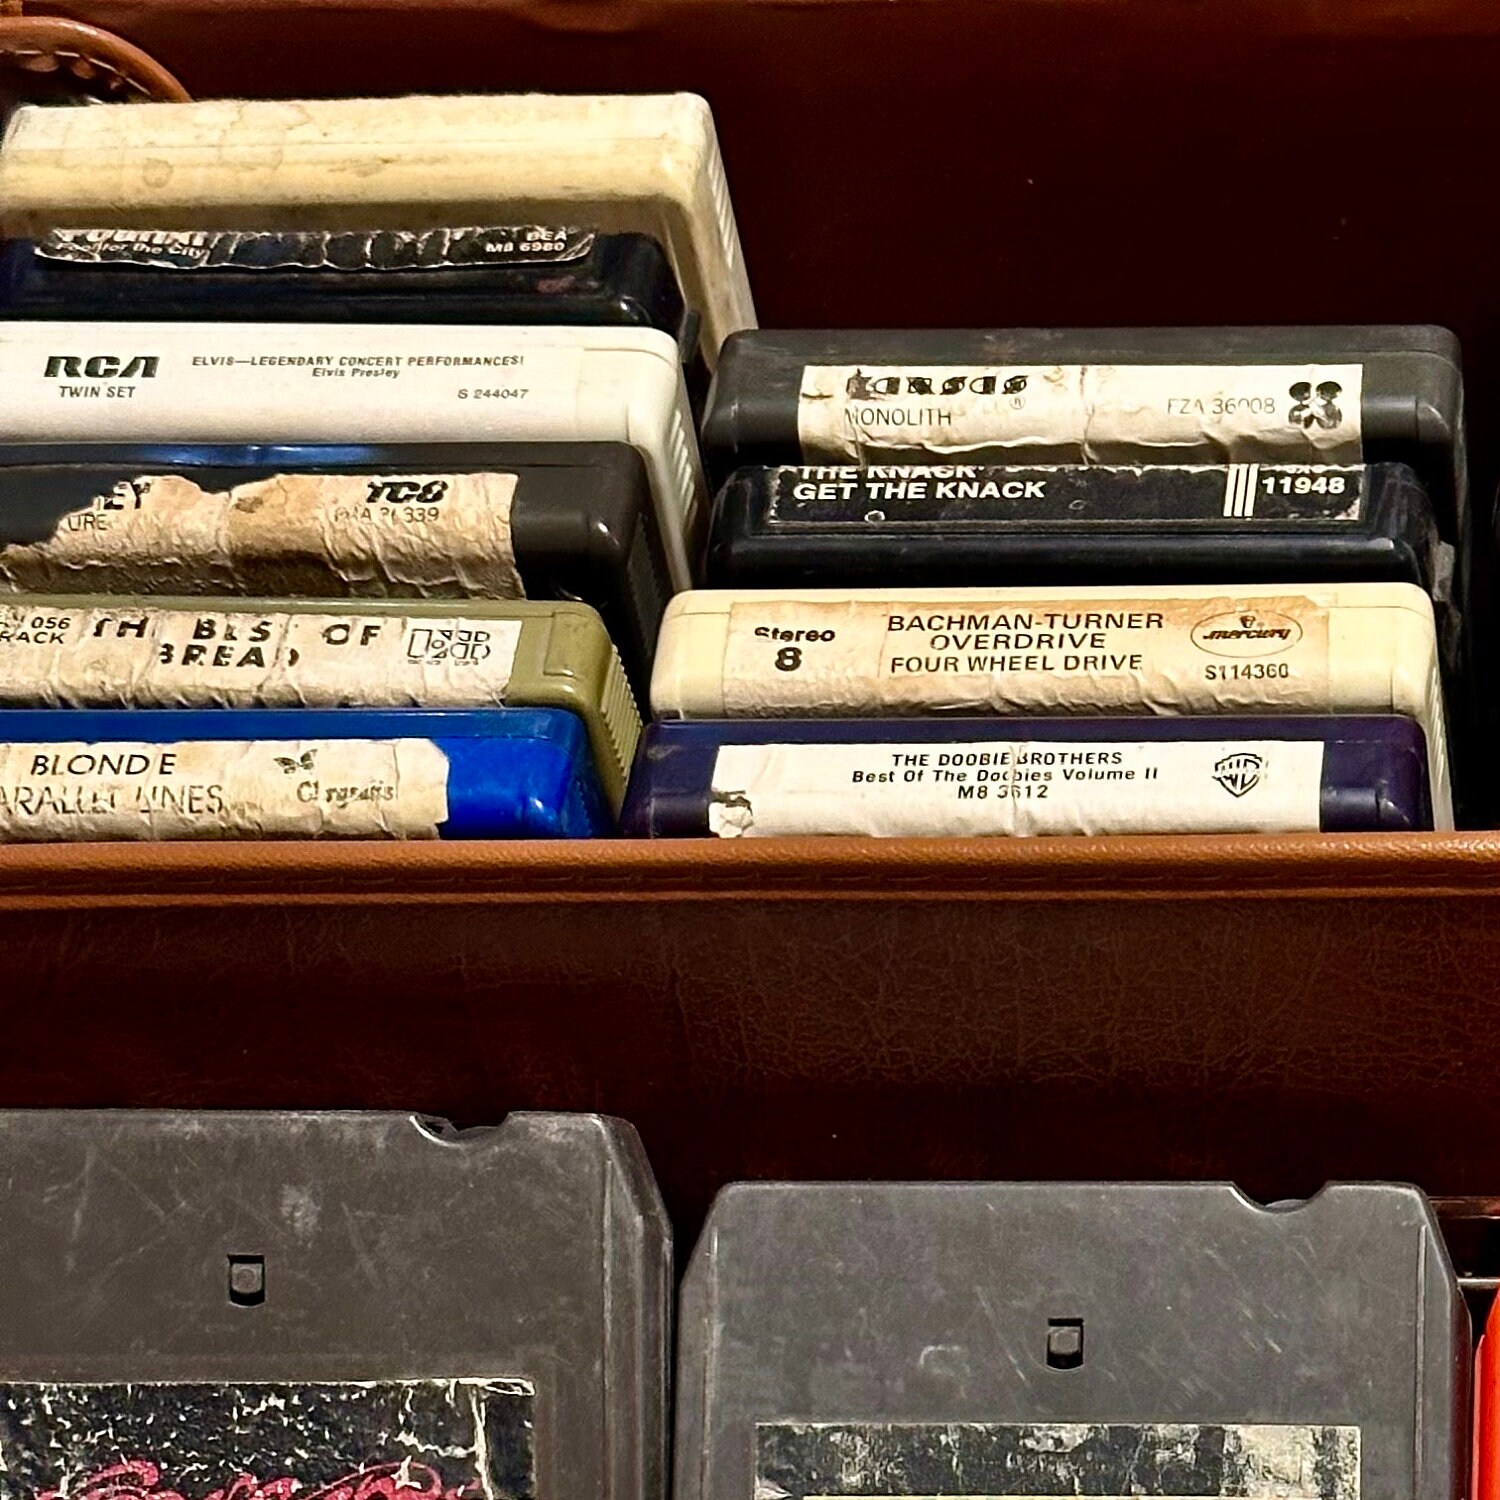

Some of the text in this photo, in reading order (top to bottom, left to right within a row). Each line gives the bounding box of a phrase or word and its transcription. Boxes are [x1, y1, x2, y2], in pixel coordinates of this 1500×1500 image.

[44, 355, 160, 379] RCA
[339, 355, 403, 367] CONCERT
[312, 368, 400, 380] Elvis Presley
[59, 386, 136, 398] TWIN SET
[457, 389, 529, 399] S 244047
[366, 480, 449, 504] TC8
[793, 480, 1047, 500] GET THE KNACK
[1262, 476, 1346, 495] 11948
[887, 612, 1164, 632] BACHMAN-TURNER
[321, 623, 381, 646] OF
[754, 626, 836, 643] Stereo
[929, 632, 1107, 652] OVERDRIVE
[774, 647, 803, 672] 8
[891, 654, 1143, 674] FOUR WHEEL DRIVE
[1205, 663, 1289, 681] S114360
[892, 752, 1123, 767] THE DOOBIE BROTHERS
[852, 770, 895, 783] Best
[904, 770, 924, 783] Of
[933, 770, 967, 783] The
[1063, 768, 1136, 781] Volume
[1145, 767, 1158, 780] II
[957, 786, 988, 800] M8
